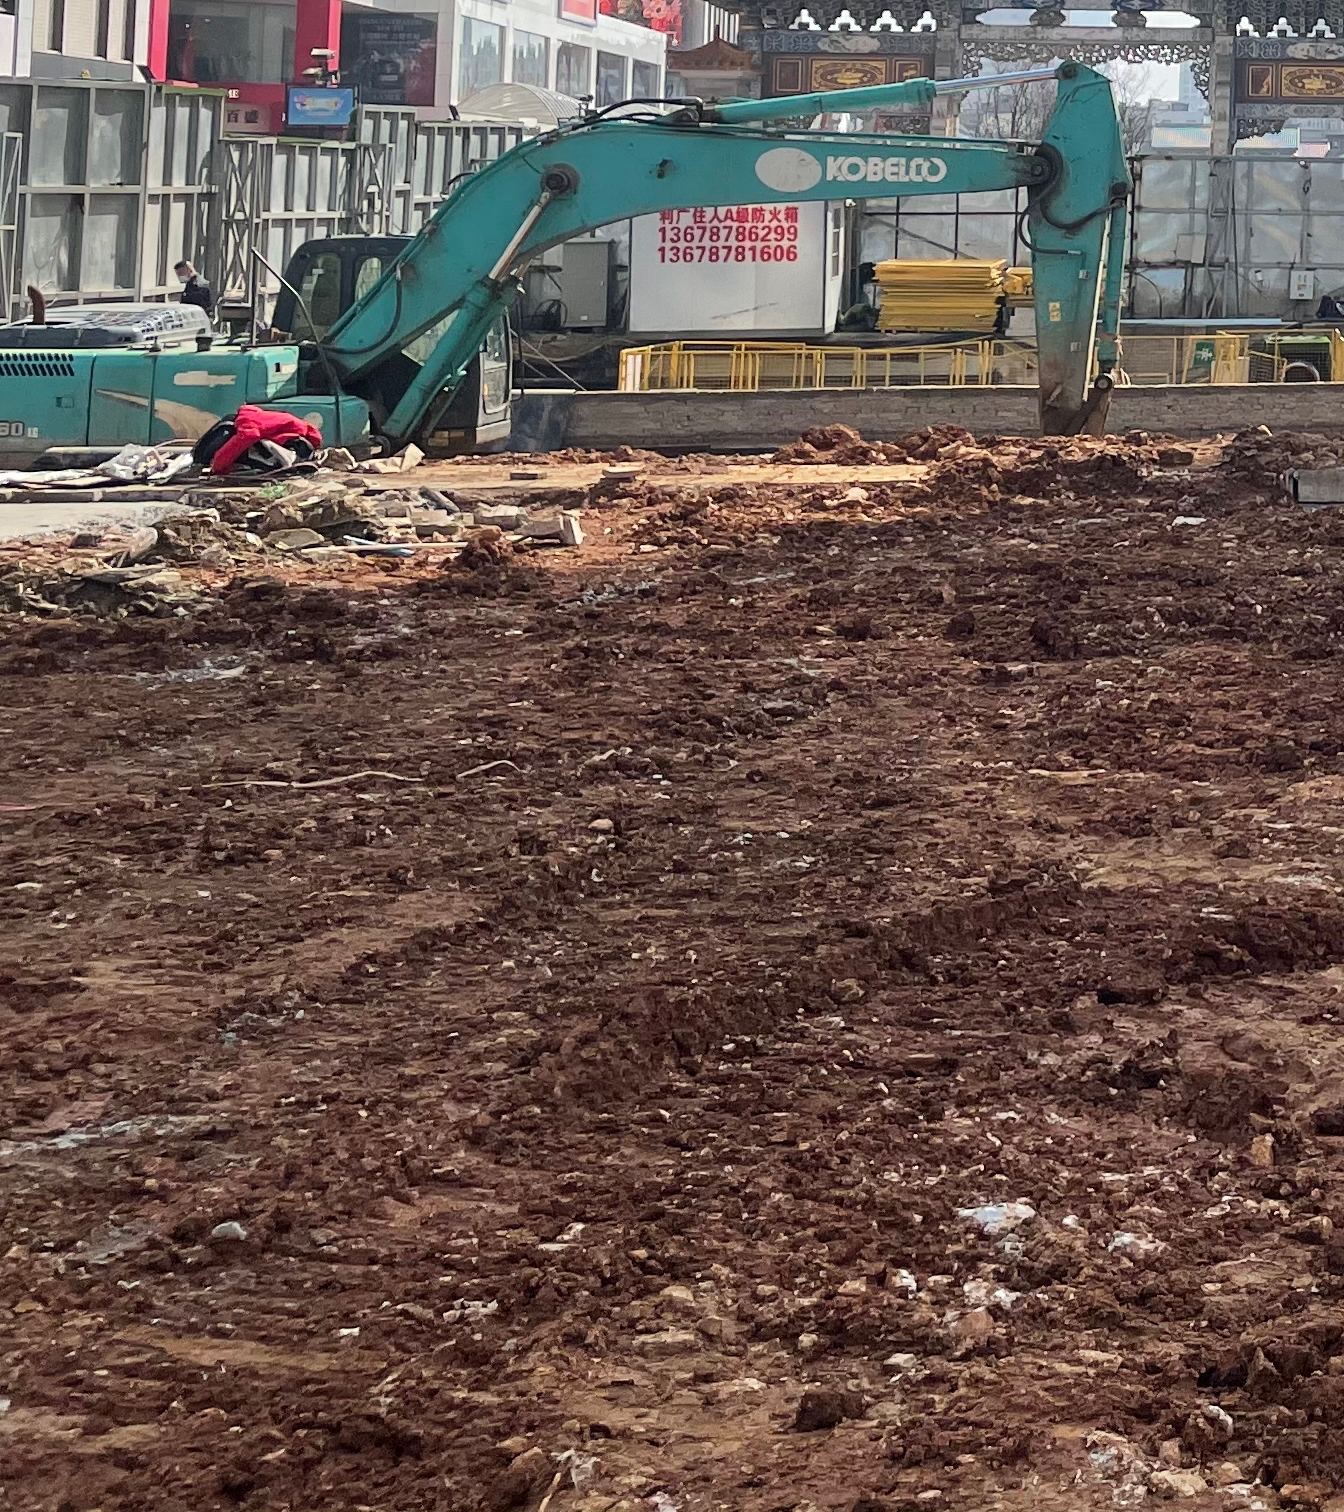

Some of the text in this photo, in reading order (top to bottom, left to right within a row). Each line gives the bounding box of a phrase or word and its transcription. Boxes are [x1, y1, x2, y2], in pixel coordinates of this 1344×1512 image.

[826, 155, 948, 183] KOBELCO
[658, 225, 798, 244] 13678786299
[657, 245, 798, 264] 13678781606
